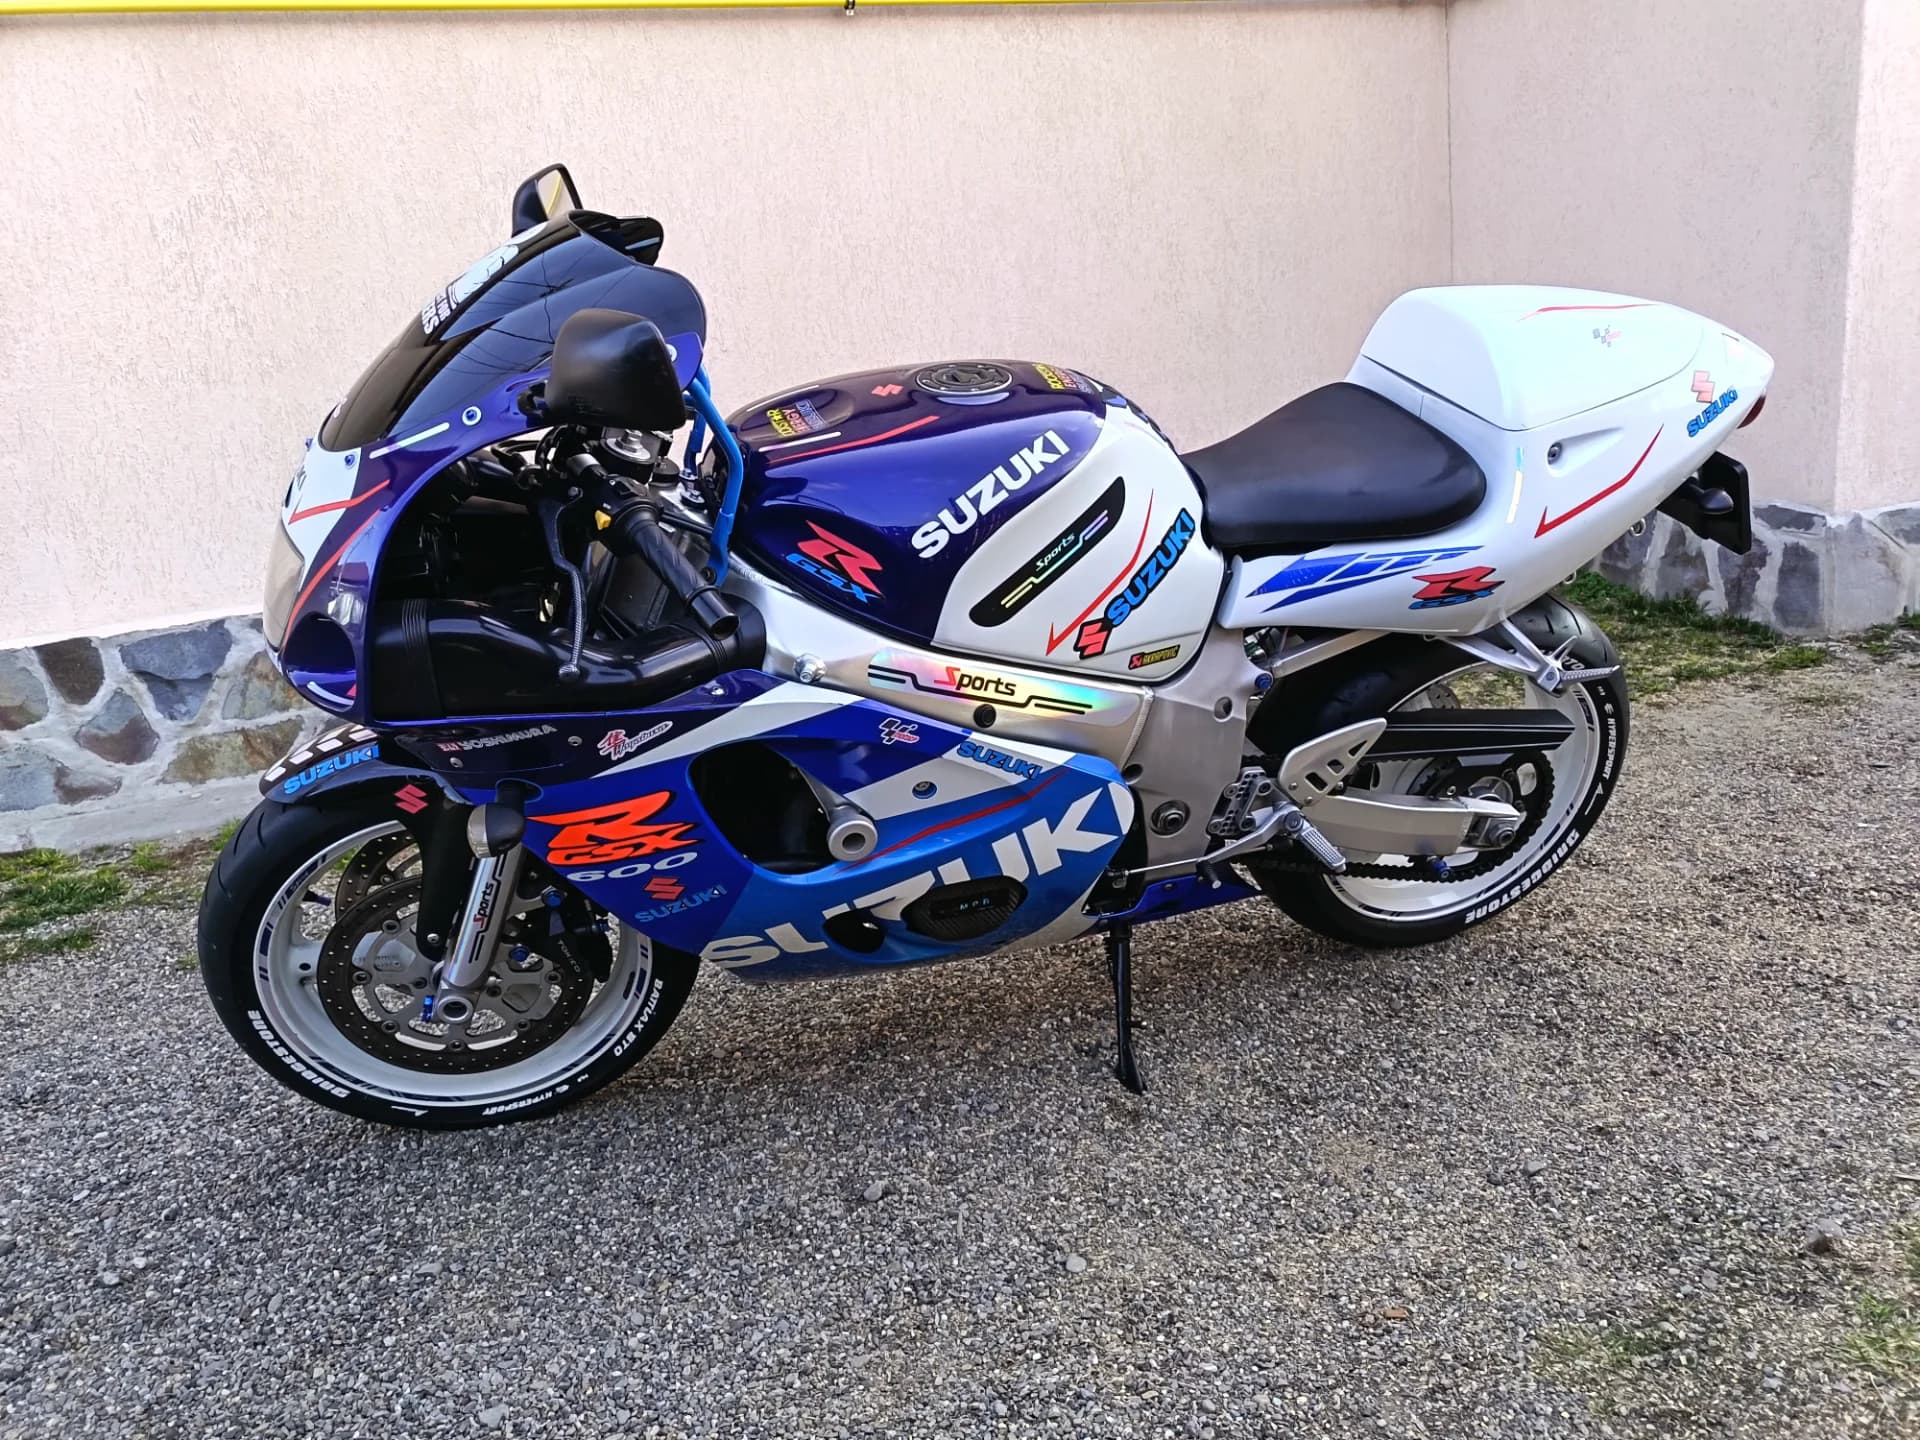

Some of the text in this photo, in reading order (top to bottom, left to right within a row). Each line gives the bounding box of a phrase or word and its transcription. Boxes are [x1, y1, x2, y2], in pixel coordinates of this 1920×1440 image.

[1686, 388, 1738, 438] SUZUKI
[911, 430, 1070, 558] SUZUKI
[1036, 532, 1075, 572] Sports
[1107, 510, 1195, 626] SUZUKI
[785, 553, 882, 603] GSX
[934, 666, 1017, 697] Sports
[458, 724, 558, 751] YOSHIMURA
[957, 740, 1043, 780] SUZUKI
[1602, 717, 1617, 780] HYPERSPORT
[283, 743, 380, 795] SUZUKI
[546, 824, 701, 866] GSX
[566, 852, 698, 882] 600
[1465, 828, 1580, 925] BRIDGESTONE
[473, 882, 495, 929] Sports
[635, 885, 728, 923] SUZUKI
[634, 978, 664, 1033] BATTLAX
[247, 1009, 352, 1098] BRIDGESTONE
[482, 1091, 553, 1116] HYPERSPORT
